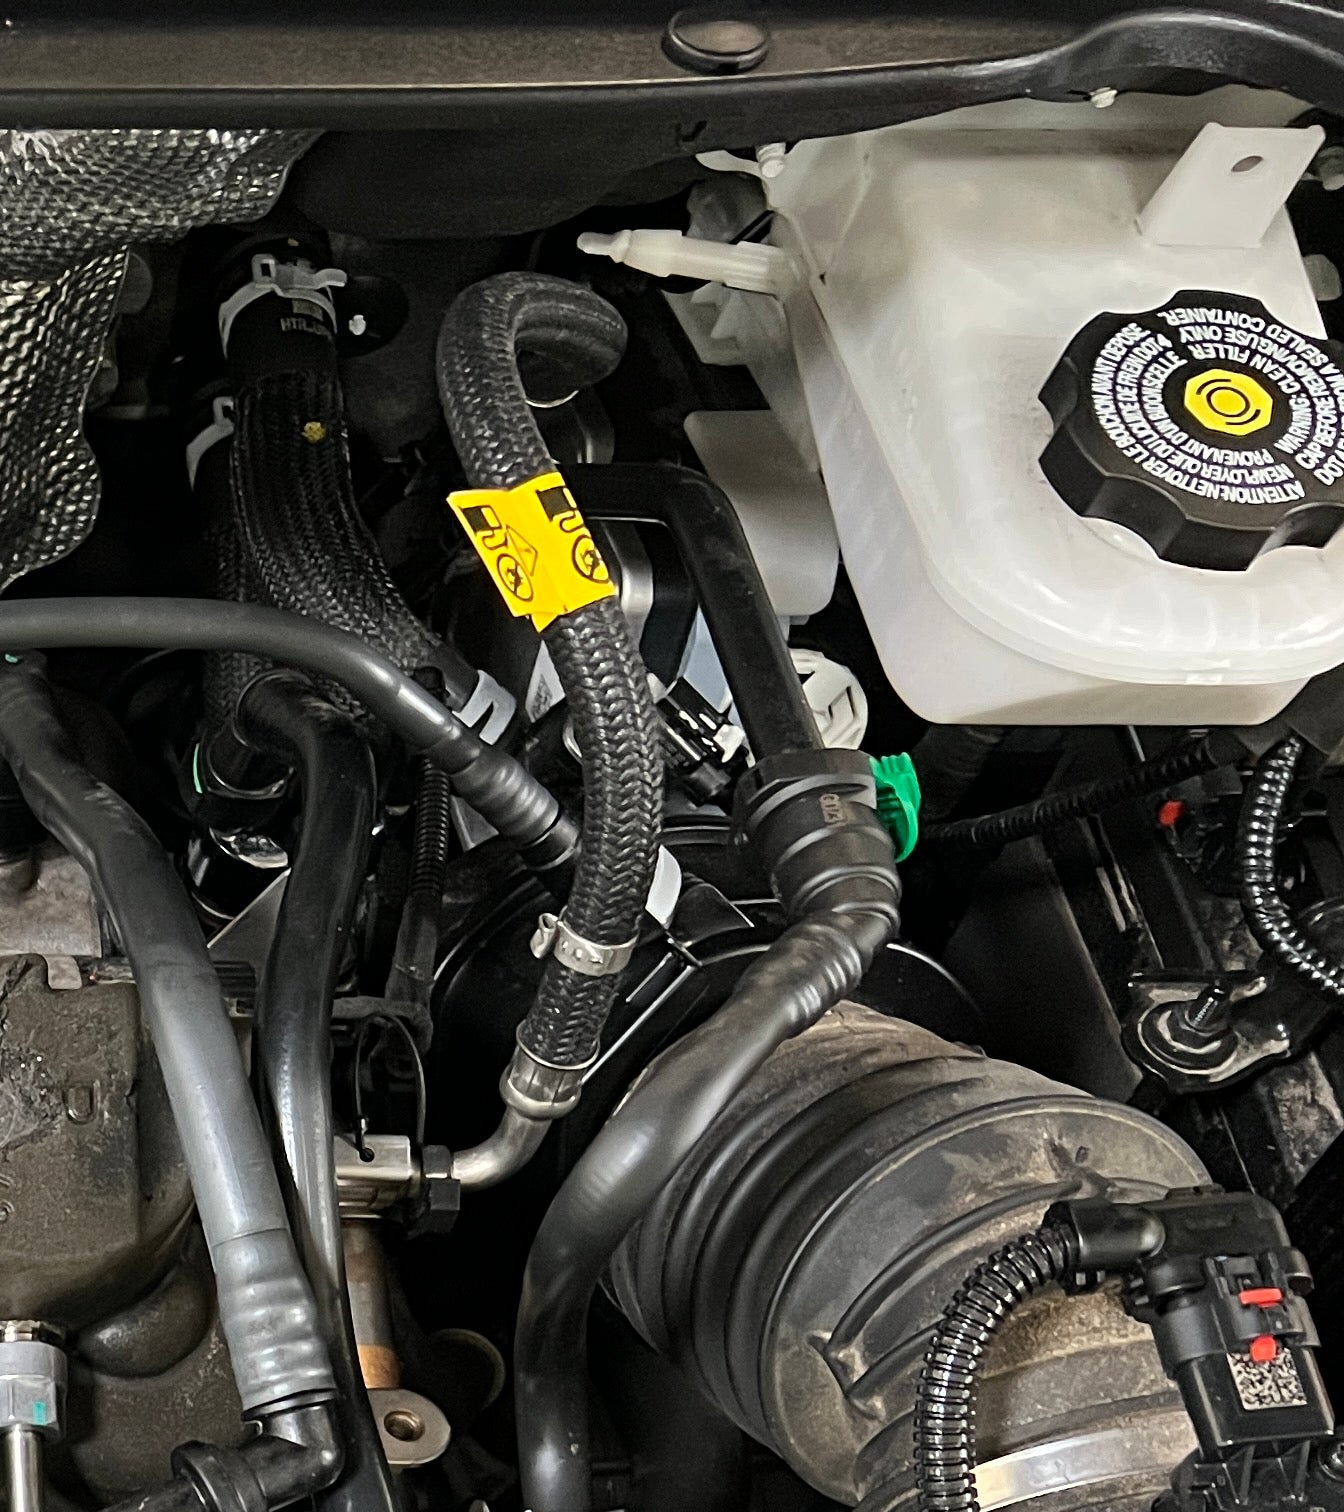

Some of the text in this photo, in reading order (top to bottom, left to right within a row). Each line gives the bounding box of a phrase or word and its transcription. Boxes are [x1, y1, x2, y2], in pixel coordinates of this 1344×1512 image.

[1179, 326, 1222, 343] ONLY
[1224, 327, 1260, 349] USE
[1266, 324, 1329, 366] SEALED
[1188, 343, 1250, 363] FILLER
[1091, 357, 1117, 395] AVANT
[1117, 354, 1147, 387] FREIN
[1250, 354, 1301, 393] CLEAN
[1116, 385, 1138, 401] DE
[1142, 387, 1169, 420] BIDON
[1092, 395, 1136, 448] BOUCHON
[1313, 396, 1337, 447] BEFORE
[1122, 444, 1149, 463] LE
[1147, 439, 1175, 458] DU
[1167, 450, 1202, 473] QUE
[1295, 442, 1326, 469] CAP
[1142, 457, 1219, 499] NETTOYER
